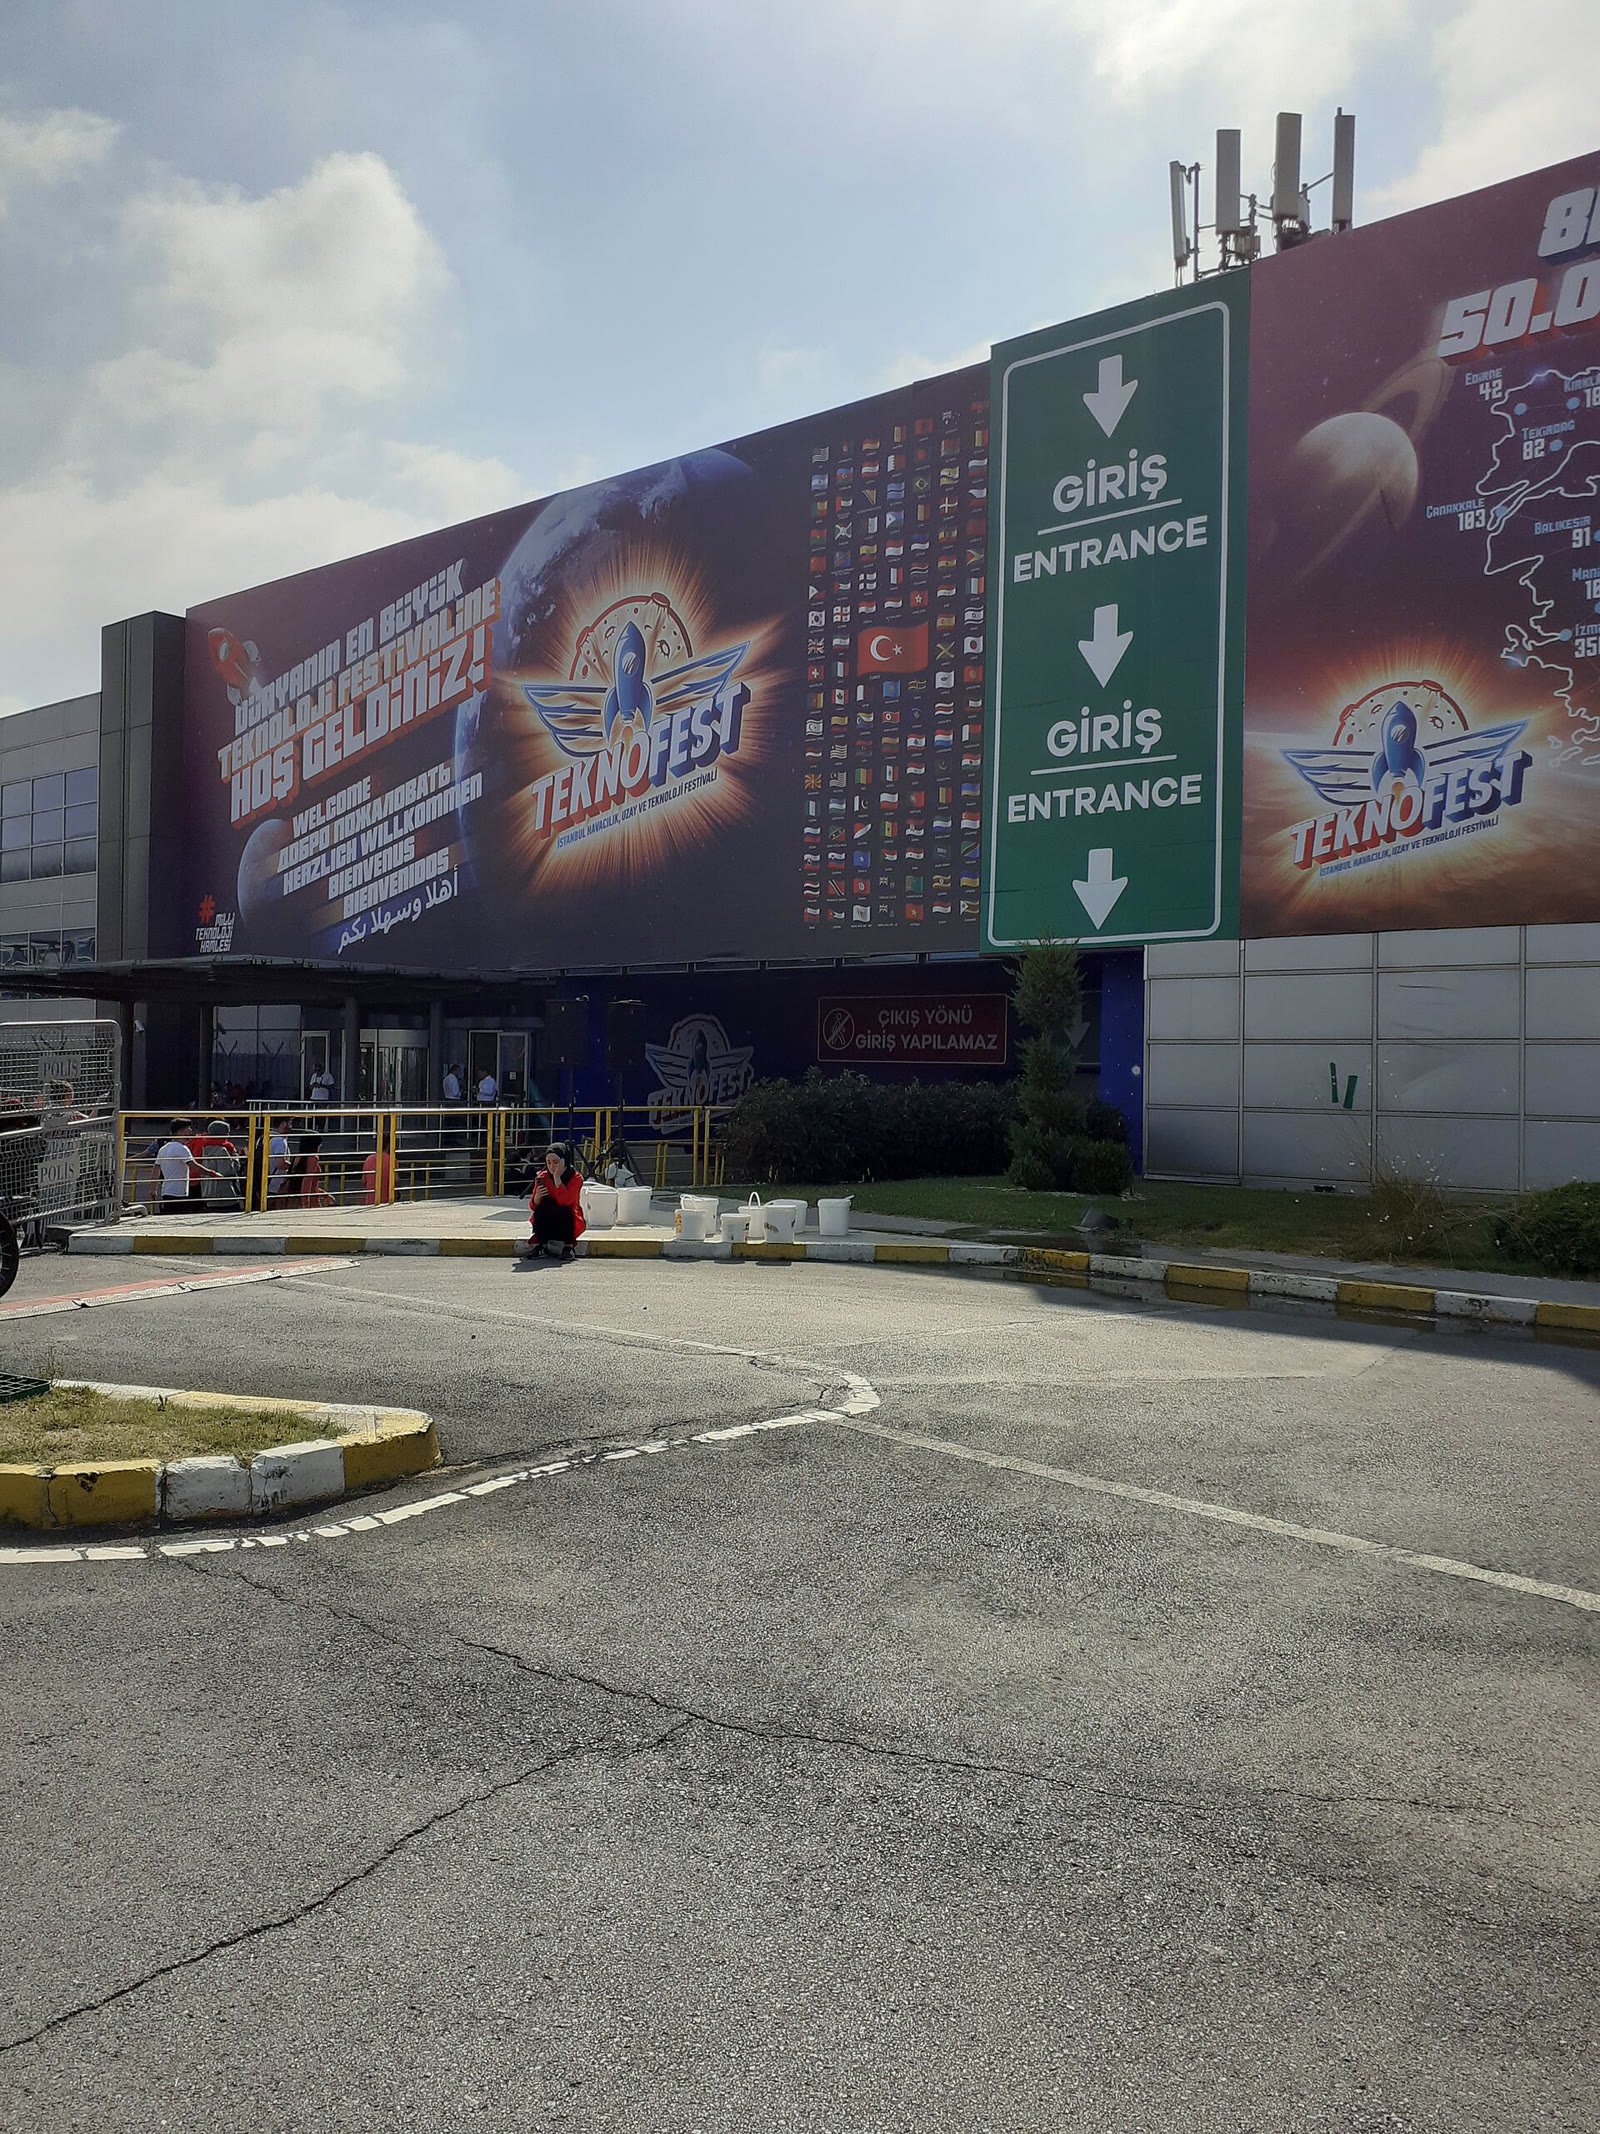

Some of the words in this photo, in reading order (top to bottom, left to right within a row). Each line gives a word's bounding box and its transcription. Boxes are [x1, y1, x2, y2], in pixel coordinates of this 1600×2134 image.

[1538, 187, 1600, 257] 8
[1480, 379, 1502, 400] 42
[1523, 438, 1545, 460] 82
[1053, 449, 1168, 513] GİRİŞ
[1014, 515, 1208, 583] ENTRANCE
[1458, 509, 1485, 531] 103
[1572, 527, 1591, 548] 91
[346, 618, 374, 666] EN
[380, 558, 465, 638] BÜYÜK
[1574, 636, 1600, 658] 35
[1047, 699, 1162, 757] GİRİŞ
[231, 742, 294, 823] HOŞ
[531, 682, 750, 839] TEKNOFEST
[277, 825, 330, 874] ДОБРО
[332, 762, 451, 841] ПОЖАЛОВАТЬ
[293, 776, 371, 838] WELCOME
[621, 804, 638, 822] UZAY
[639, 800, 647, 814] VE
[1007, 773, 1202, 823] ENTRANCE
[1290, 750, 1533, 870] TEKNOFEST
[283, 841, 357, 896] HERZLICH
[360, 772, 483, 858] WILLKOMMEN
[1411, 838, 1421, 850] VE
[328, 836, 415, 900] BIENVENUS
[343, 848, 449, 919] BIENVENIDOS
[337, 920, 368, 955] بكم
[855, 1029, 897, 1052] GİRİŞ
[899, 1032, 998, 1052] YAPILAMAZ
[878, 1009, 921, 1027] ÇIKIŞ
[924, 1003, 973, 1025] YÖNÜ
[43, 1059, 78, 1076] POLİS
[650, 1066, 752, 1124] TEKNOFEST
[40, 1161, 75, 1183] POLİS
